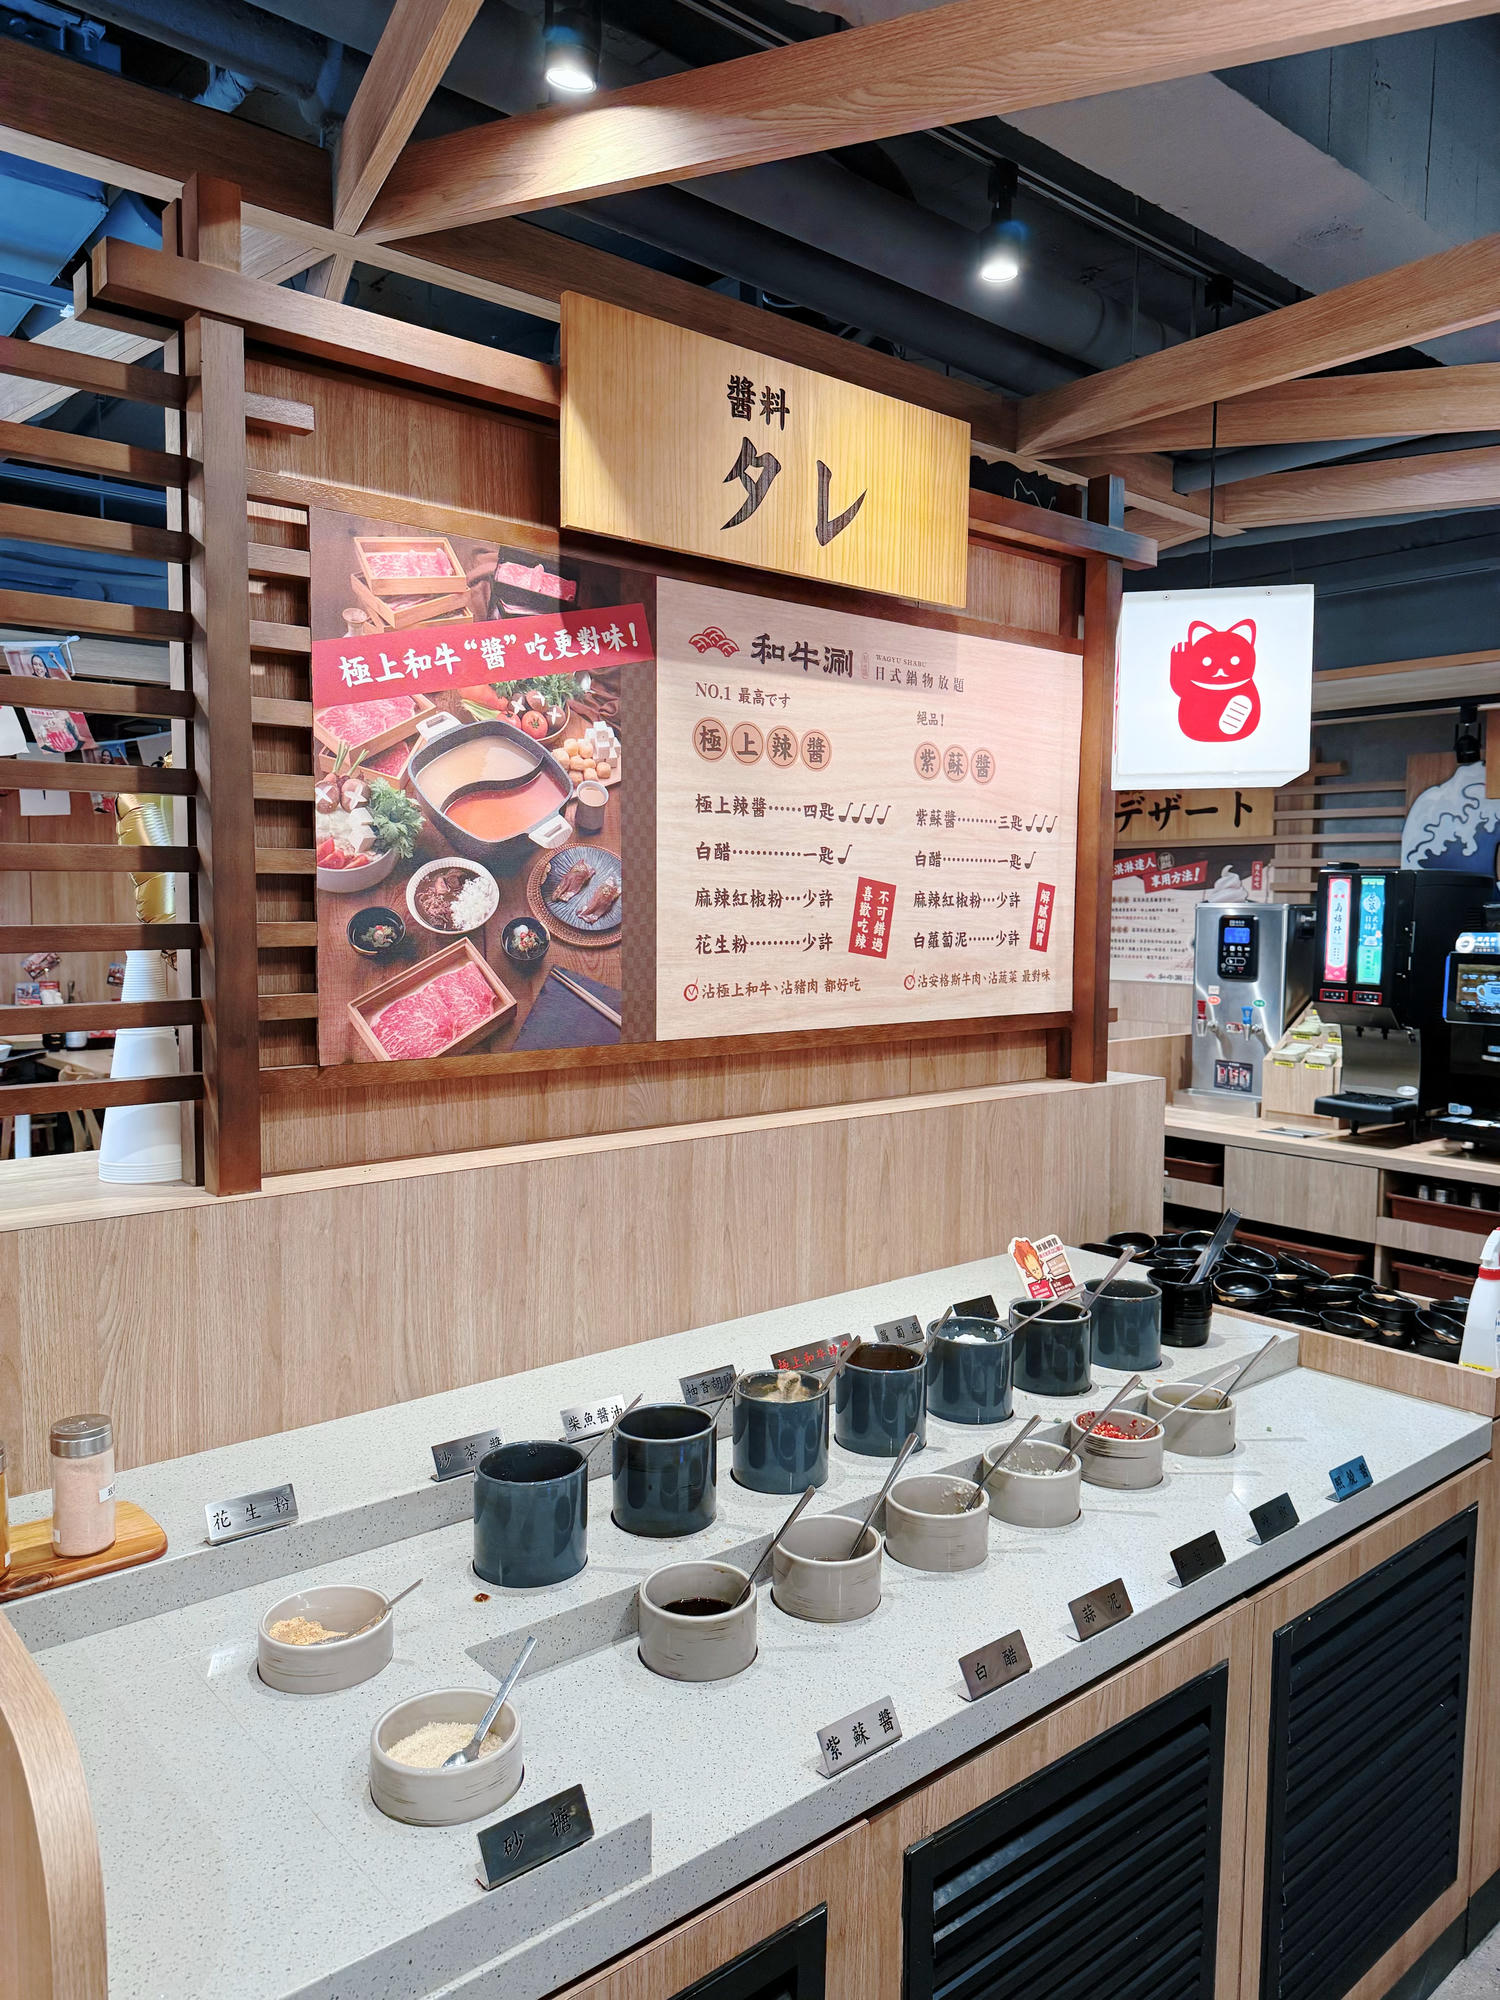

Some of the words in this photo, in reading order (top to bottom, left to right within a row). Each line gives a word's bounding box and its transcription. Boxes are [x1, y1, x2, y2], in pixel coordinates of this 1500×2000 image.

[727, 375, 790, 431] 醬料
[720, 436, 868, 547] タレ
[750, 633, 854, 678] 和牛涮
[876, 654, 901, 664] WAGYU
[903, 658, 927, 668] SHABU
[876, 666, 964, 693] 日式鍋物放題
[695, 682, 731, 701] NO.1
[738, 687, 791, 708] 最高です
[698, 724, 827, 765] 極上辣醬
[918, 748, 990, 779] 紫蘇醬
[695, 793, 767, 818] 極上辣醬
[803, 802, 835, 821] 四匙
[915, 808, 957, 829] 紫蘇醬
[997, 814, 1023, 832] 三匙
[1114, 791, 1253, 833] デザート
[695, 841, 731, 862] 白醋
[803, 846, 834, 865] 一匙
[914, 850, 942, 868] 白醋
[997, 853, 1022, 870] 一匙
[1112, 856, 1157, 875] 淇淋達人
[694, 887, 784, 909] 麻辣紅椒粉
[802, 889, 834, 909] 少許
[913, 890, 982, 909] 麻辣紅椒粉
[996, 891, 1021, 909] 少許
[855, 885, 874, 949] 喜歡吃辣
[871, 889, 890, 953] 不可錯過
[695, 934, 749, 955] 花生粉
[802, 932, 834, 952] 少許
[913, 931, 968, 949] 白蘿蔔泥
[996, 930, 1020, 947] 少許
[824, 976, 862, 993] 都好吃
[1022, 968, 1051, 983] 最對味
[567, 1404, 624, 1433] 柴魚醬油
[213, 1495, 290, 1531] 花生粉
[1081, 1592, 1122, 1624] 蒜泥
[974, 1647, 1018, 1682] 白醋
[826, 1707, 895, 1762] 紫蘇醬
[503, 1807, 573, 1861] 砂糖
